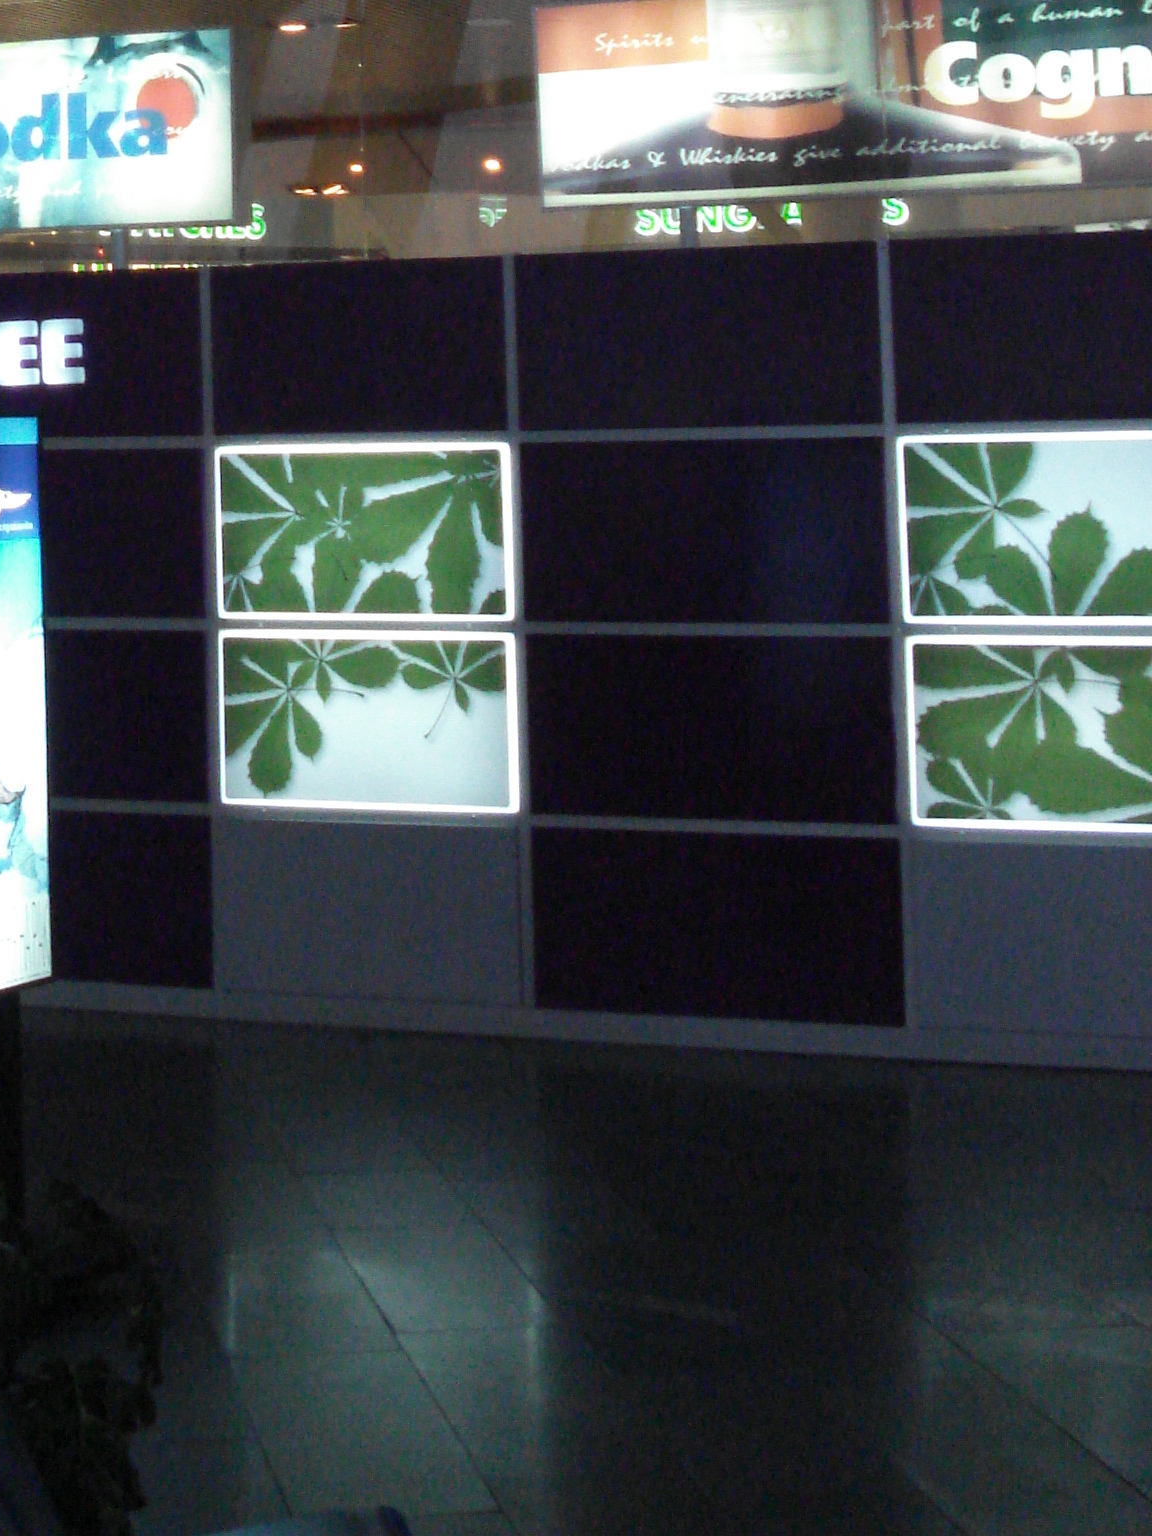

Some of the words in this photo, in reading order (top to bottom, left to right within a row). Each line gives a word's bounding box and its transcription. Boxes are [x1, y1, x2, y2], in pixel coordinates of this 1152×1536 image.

[951, 7, 981, 33] of
[997, 12, 1016, 24] a
[1031, 2, 1125, 25] human
[594, 32, 675, 56] Spirits
[923, 40, 1152, 119] Cogn
[648, 150, 668, 169] &
[679, 145, 779, 168] Whiskies
[794, 143, 843, 166] give
[855, 132, 1001, 157] additional
